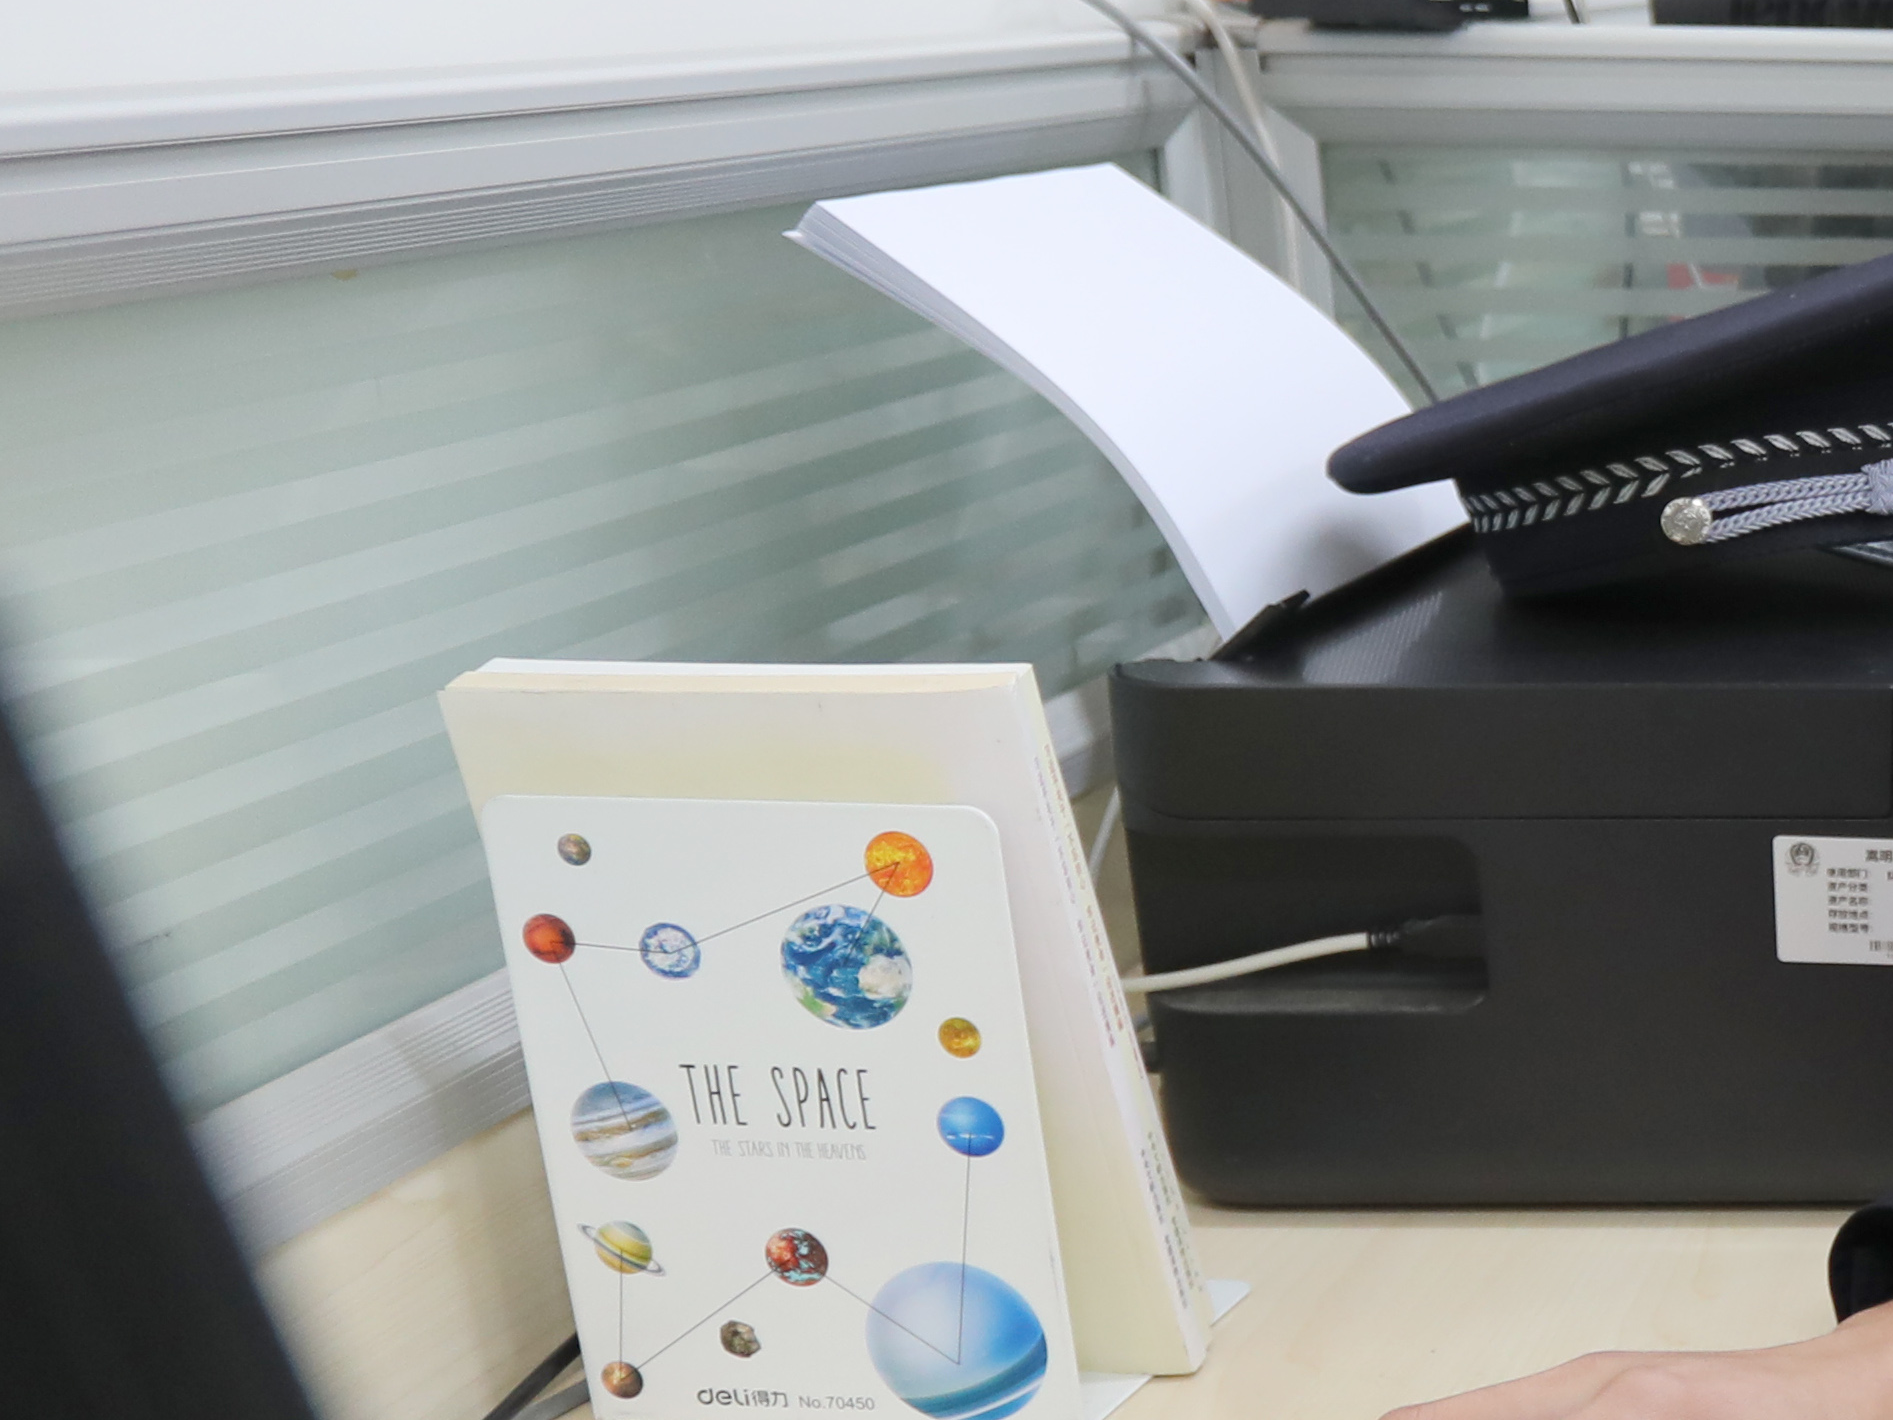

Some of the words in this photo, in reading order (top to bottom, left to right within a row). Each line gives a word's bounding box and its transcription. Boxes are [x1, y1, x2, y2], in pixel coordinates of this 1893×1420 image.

[678, 1063, 749, 1126] THE
[770, 1066, 877, 1130] SPACE
[711, 1139, 733, 1157] THE
[737, 1140, 775, 1158] STARS
[776, 1142, 792, 1158] IN
[793, 1142, 815, 1160] THE
[816, 1142, 867, 1161] HEAVENS
[798, 1395, 876, 1411] No.70450
